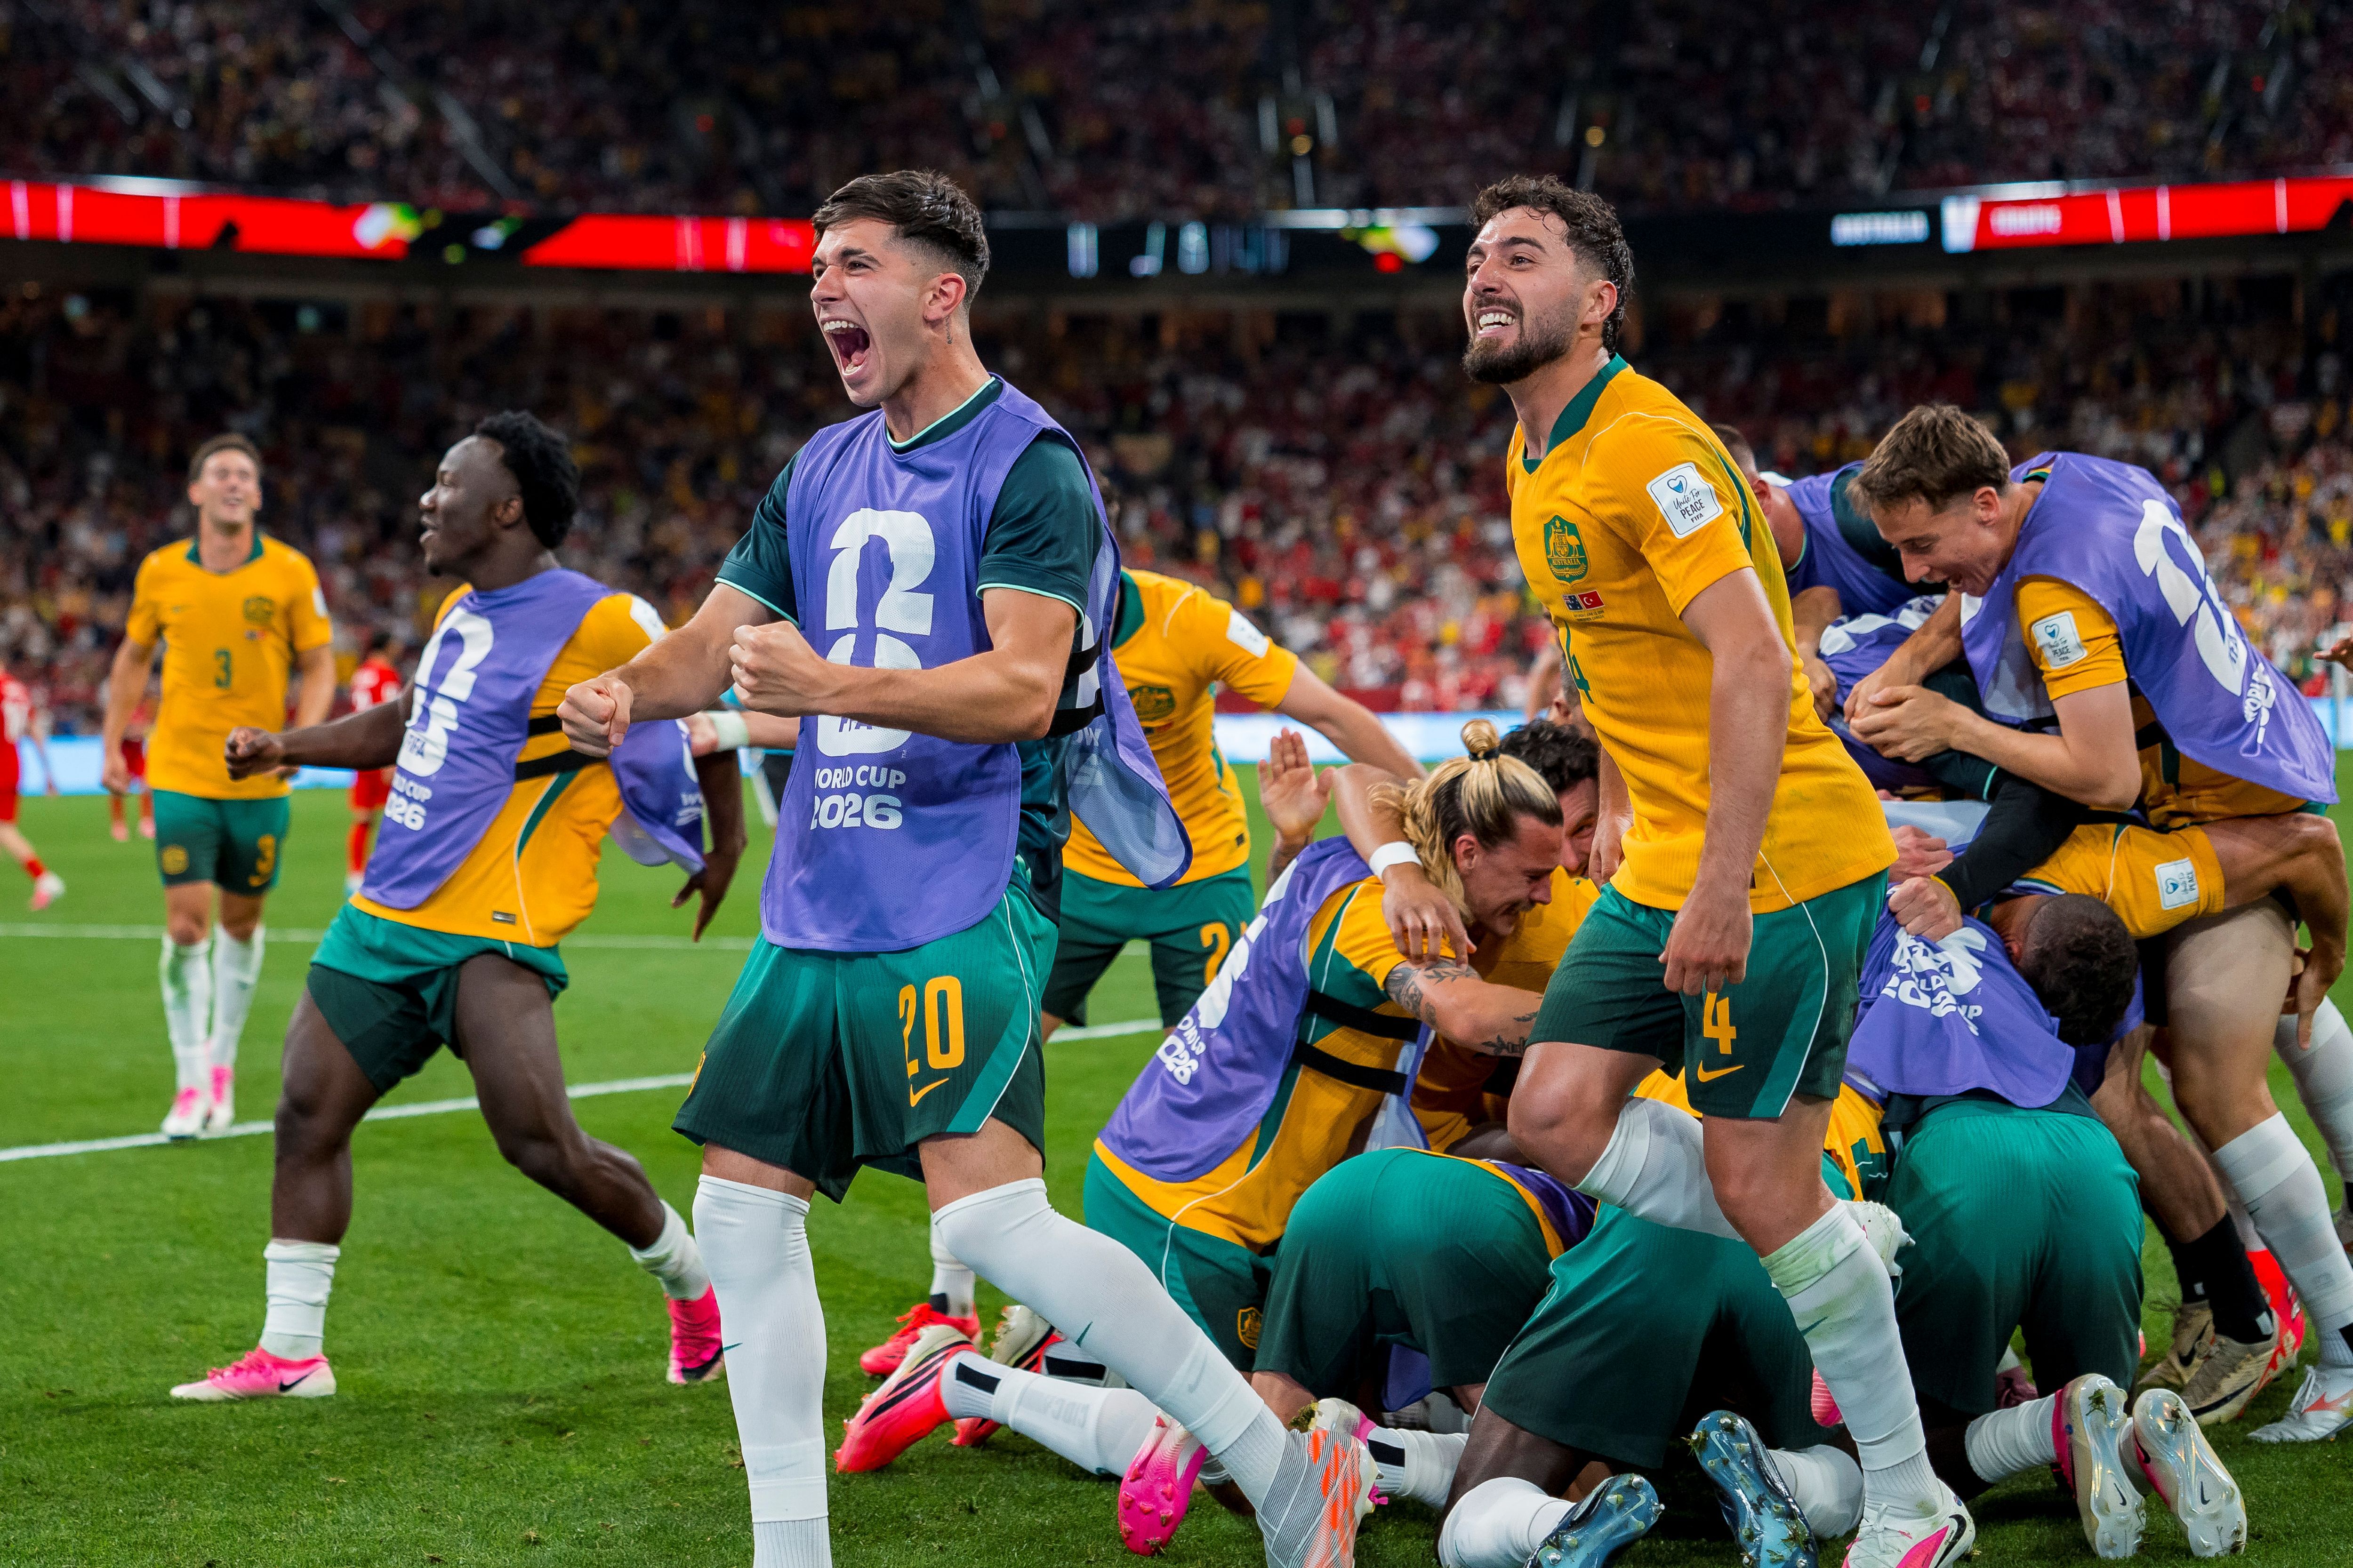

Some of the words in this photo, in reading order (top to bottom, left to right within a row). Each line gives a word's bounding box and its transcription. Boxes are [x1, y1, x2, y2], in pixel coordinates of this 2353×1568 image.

[1673, 495, 1691, 510] Unite
[1689, 488, 1700, 501] For
[1680, 499, 1705, 519] PEACE
[1691, 513, 1703, 523] FIFA
[214, 648, 232, 689] 3
[1563, 618, 1595, 704] 4
[856, 765, 906, 789] CUP
[810, 793, 903, 830] 2026
[249, 834, 276, 887] 3
[899, 976, 964, 1079] 20
[1703, 992, 1736, 1055] 4
